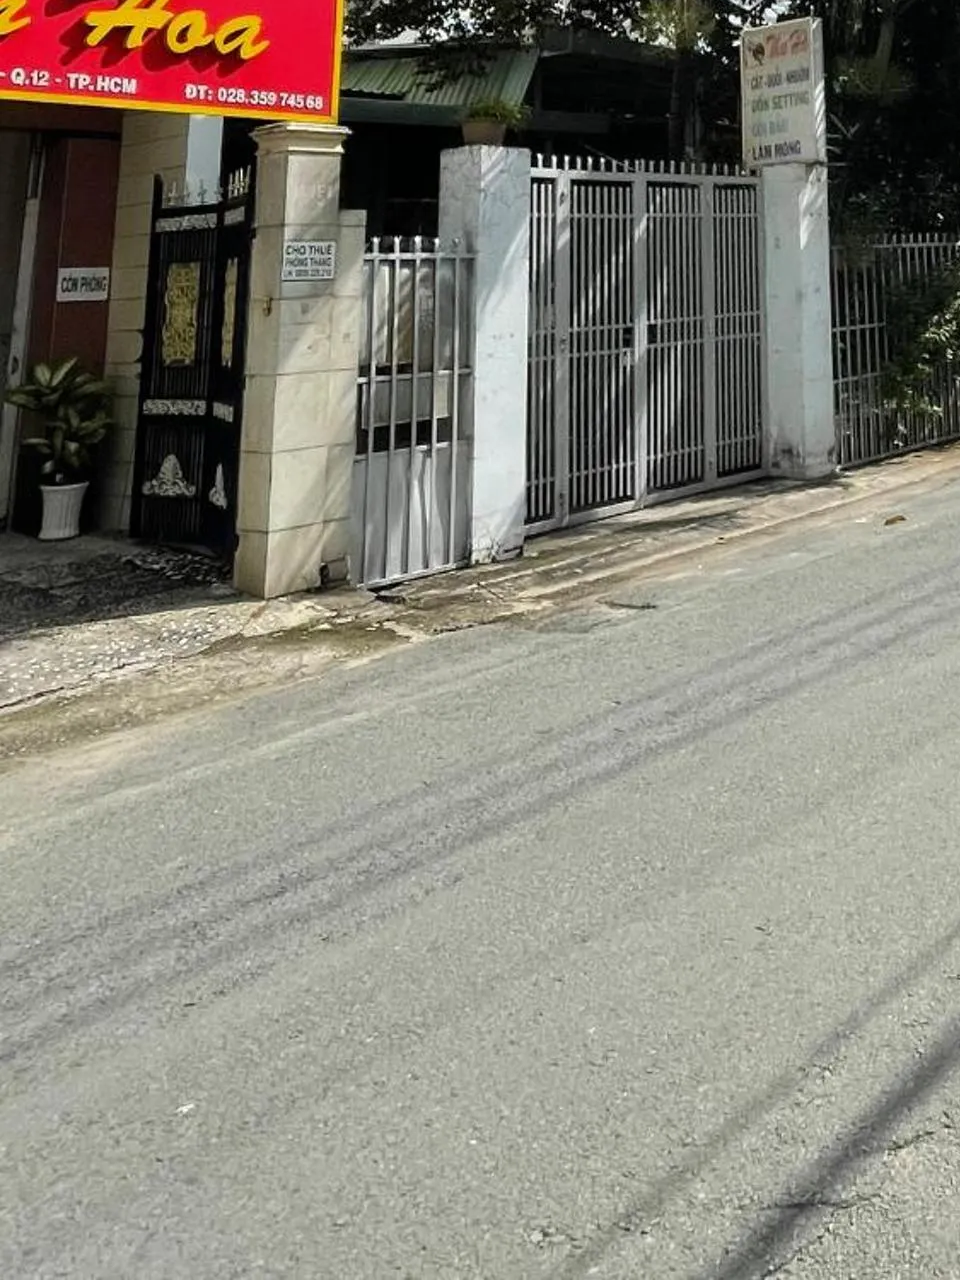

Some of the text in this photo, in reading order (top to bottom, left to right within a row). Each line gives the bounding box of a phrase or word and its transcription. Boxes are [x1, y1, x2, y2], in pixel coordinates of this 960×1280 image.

[10, 67, 50, 87] Q.12
[66, 72, 138, 95] TP.HCM
[185, 83, 214, 101] ĐT:
[217, 87, 277, 106] 028.359
